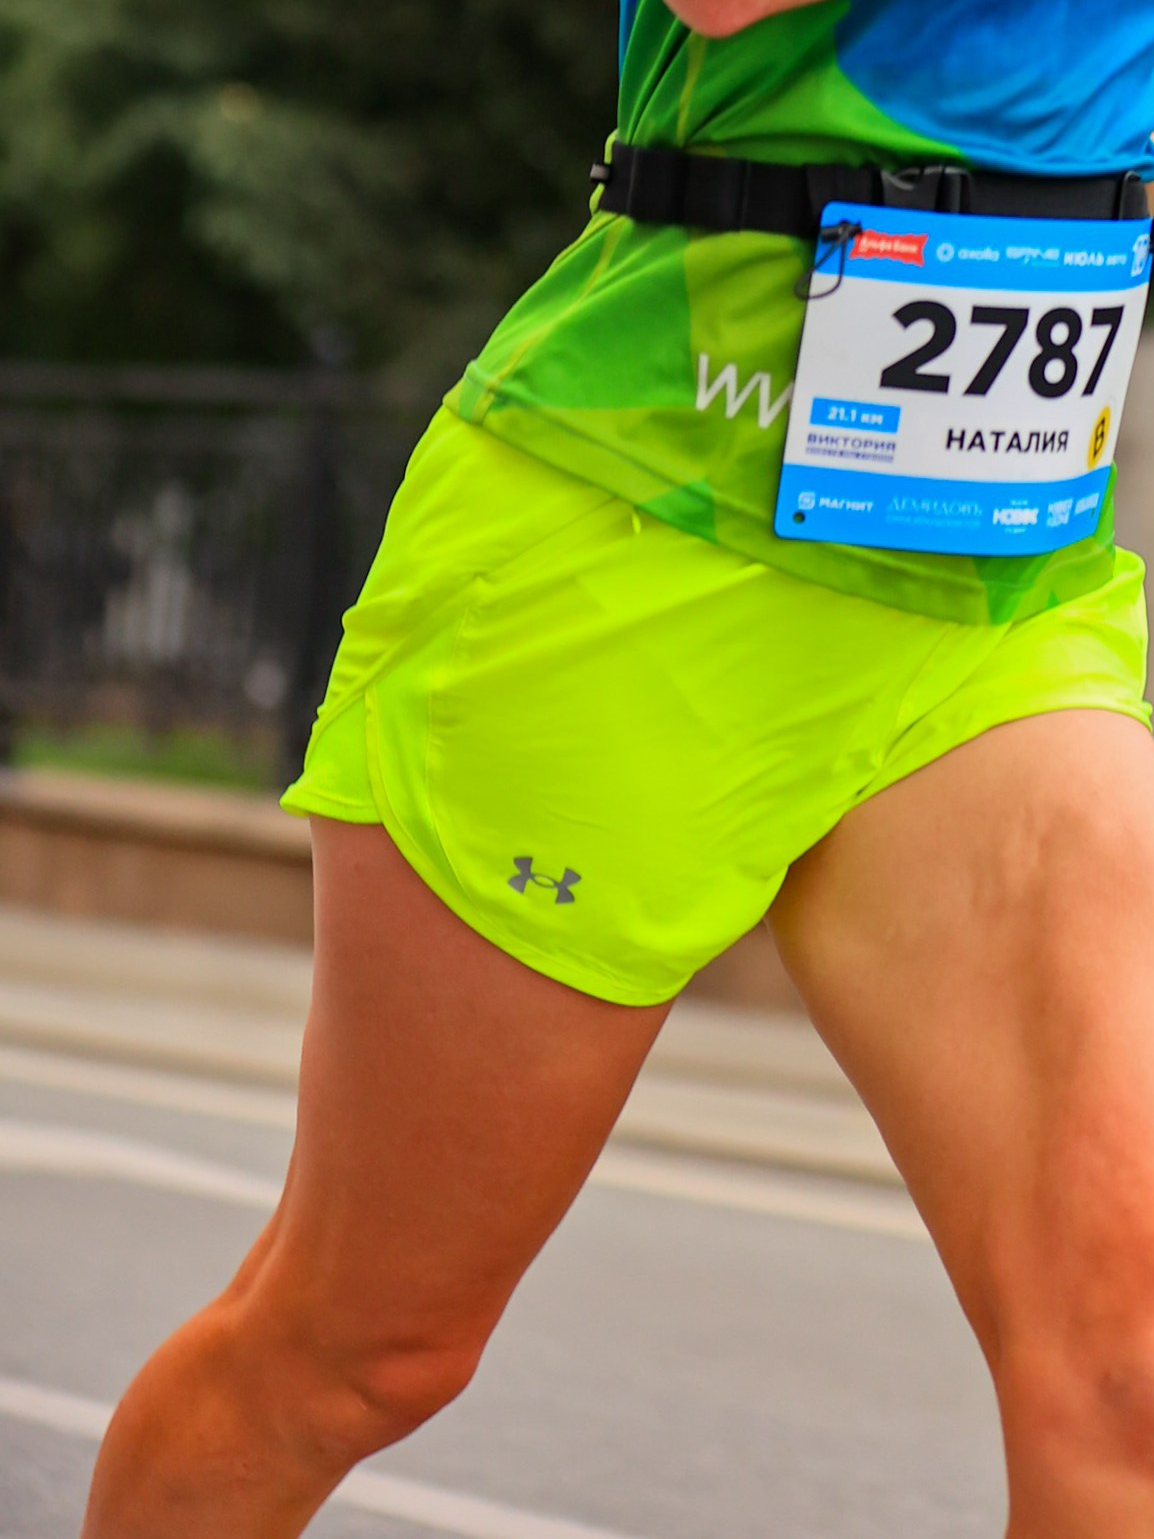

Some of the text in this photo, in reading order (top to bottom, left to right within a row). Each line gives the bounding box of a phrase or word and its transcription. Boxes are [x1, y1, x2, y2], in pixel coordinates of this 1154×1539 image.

[879, 300, 1126, 399] 2787
[827, 406, 857, 423] 21.1
[807, 433, 897, 452] ВИКТОРИЯ
[945, 428, 1070, 454] НАТАЛИЯ
